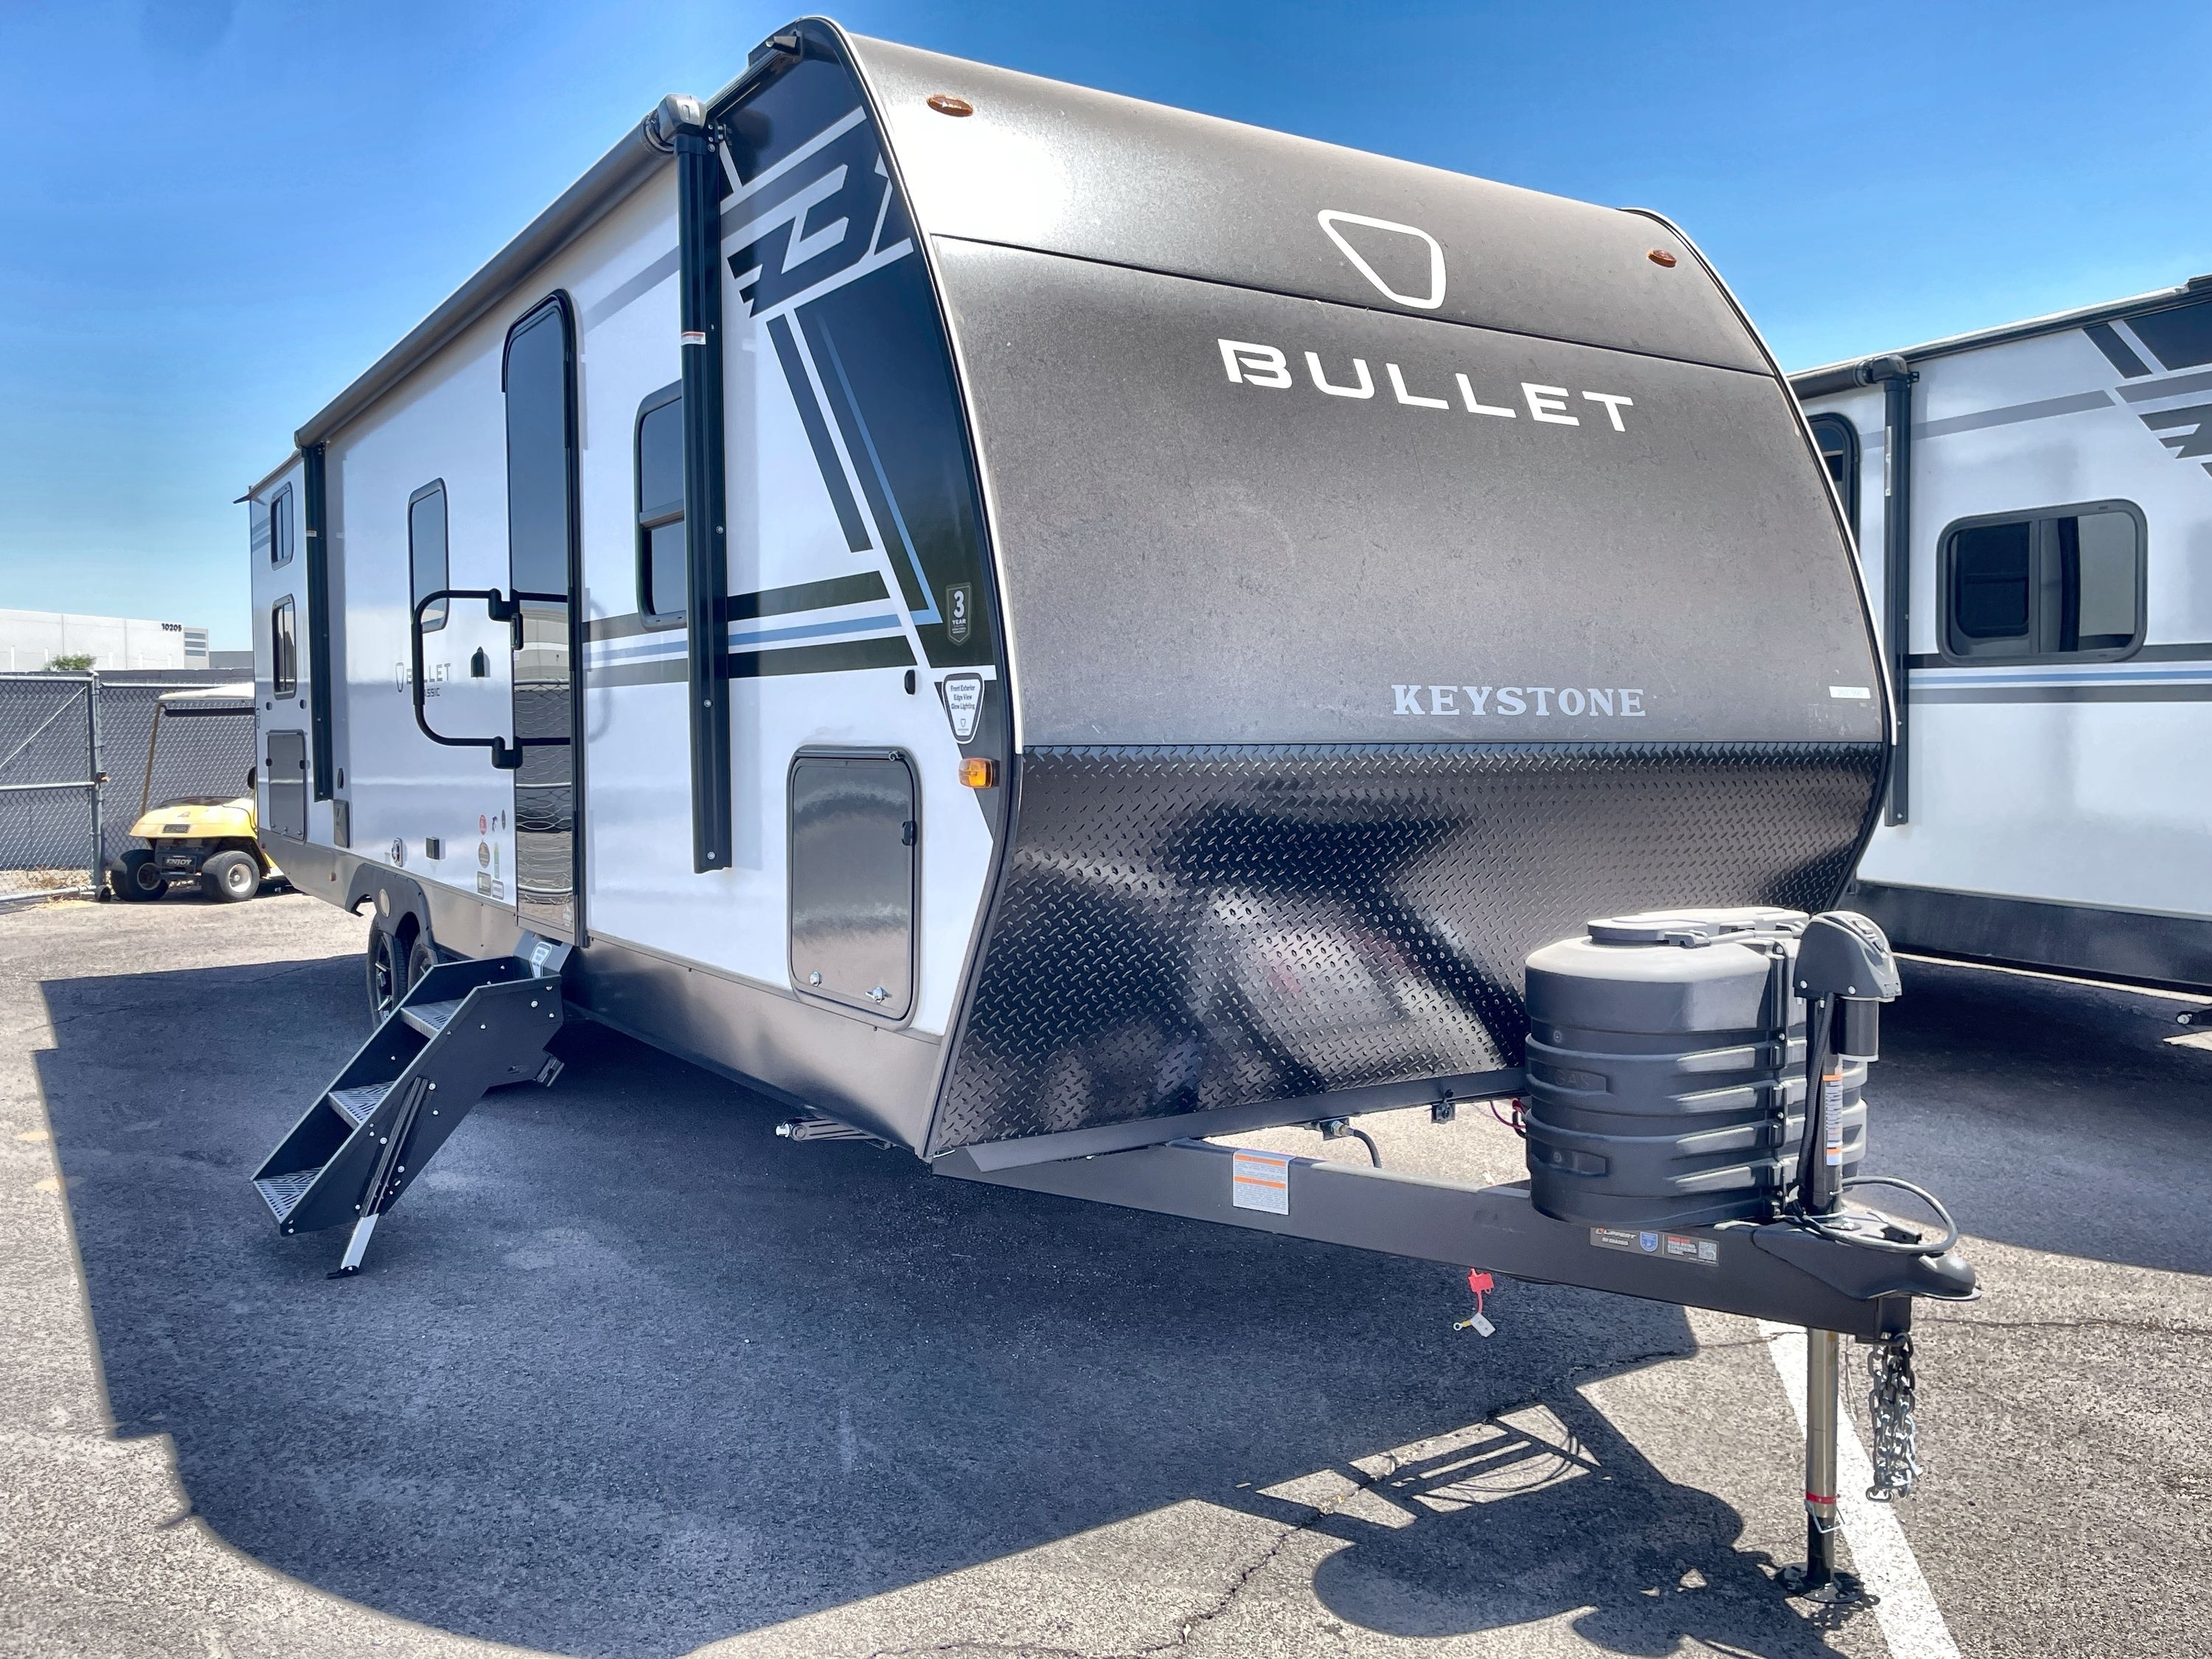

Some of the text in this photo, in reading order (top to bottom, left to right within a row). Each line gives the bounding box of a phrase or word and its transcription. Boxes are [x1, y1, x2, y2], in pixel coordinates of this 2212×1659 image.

[1217, 338, 1634, 432] BULLET
[953, 590, 965, 618] 3
[161, 623, 182, 632] 10205
[1391, 684, 1646, 717] KEYSTONE
